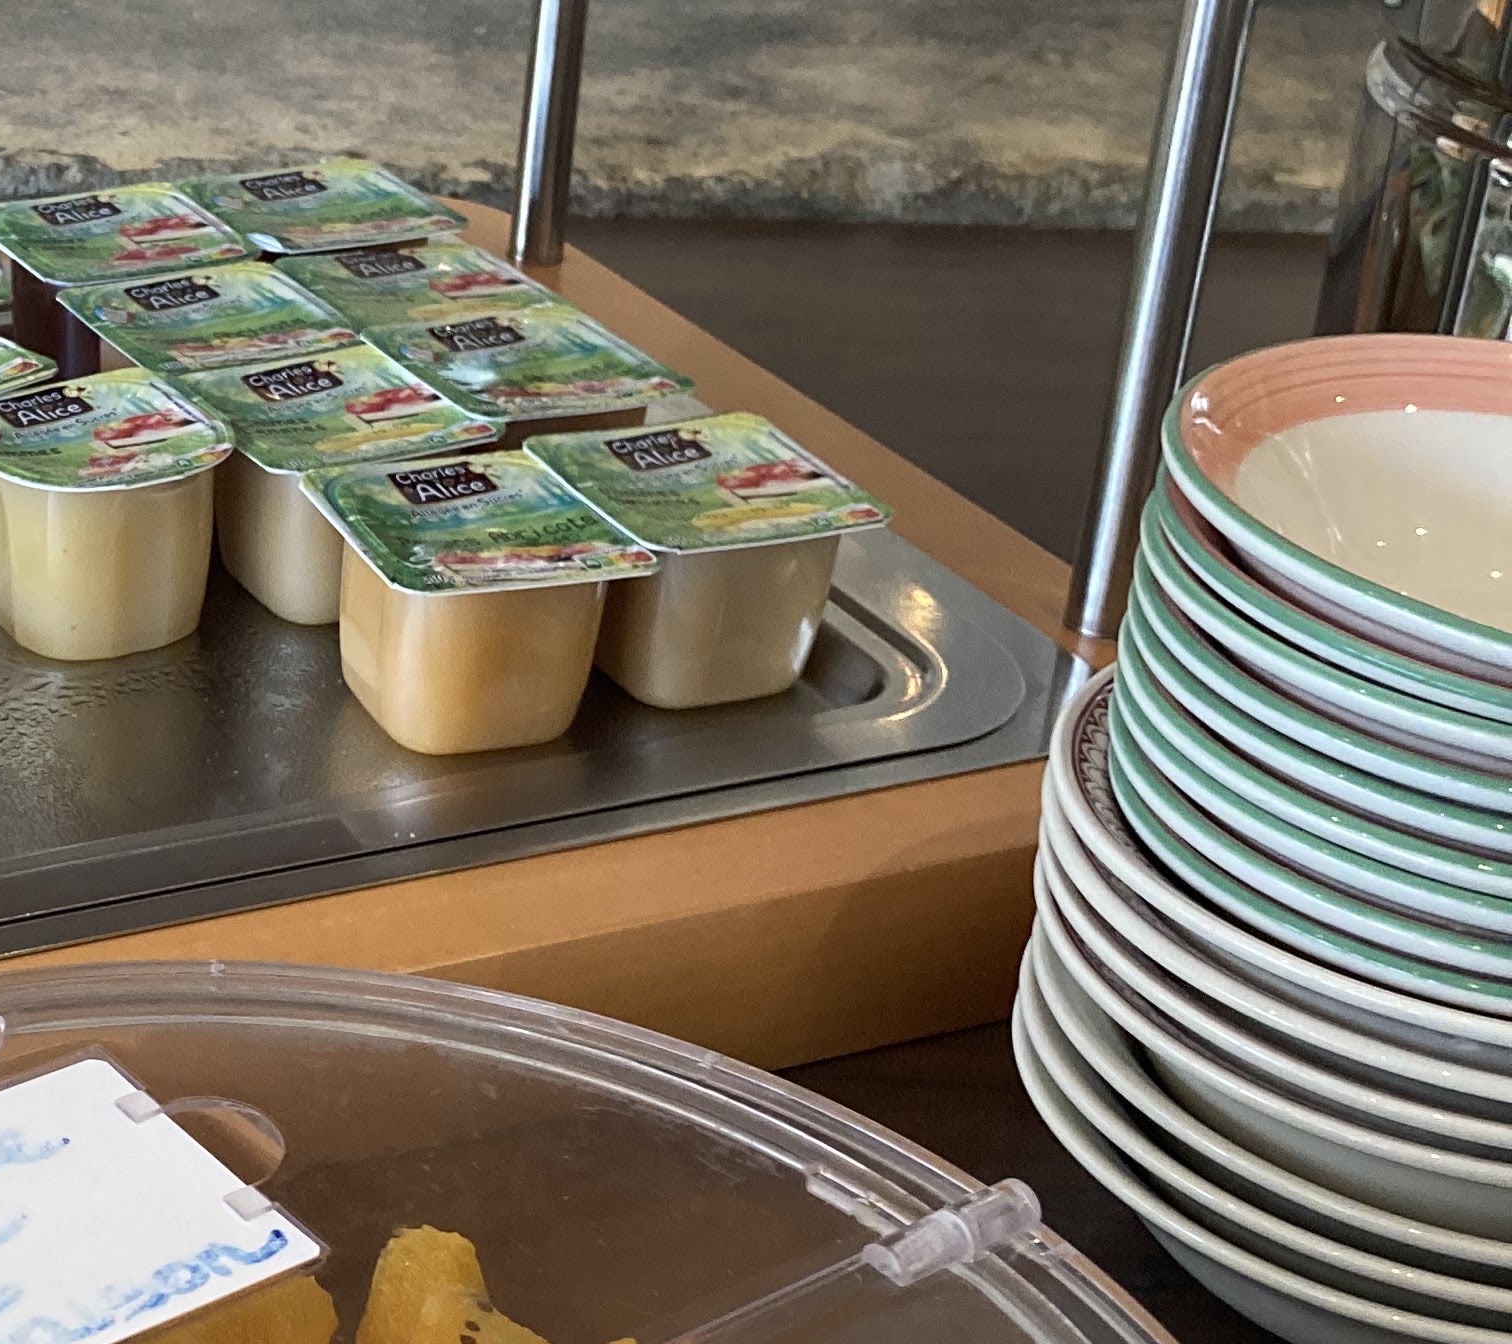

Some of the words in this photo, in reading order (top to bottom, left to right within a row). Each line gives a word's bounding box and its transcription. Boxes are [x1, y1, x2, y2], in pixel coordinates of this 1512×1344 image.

[56, 206, 115, 224] Alice
[149, 289, 211, 310] Alice
[453, 331, 514, 351] Alice
[269, 377, 334, 399] Alice
[17, 402, 83, 427] Alice
[634, 446, 700, 469] Alice
[394, 464, 468, 486] Charles
[415, 479, 487, 504] Alice
